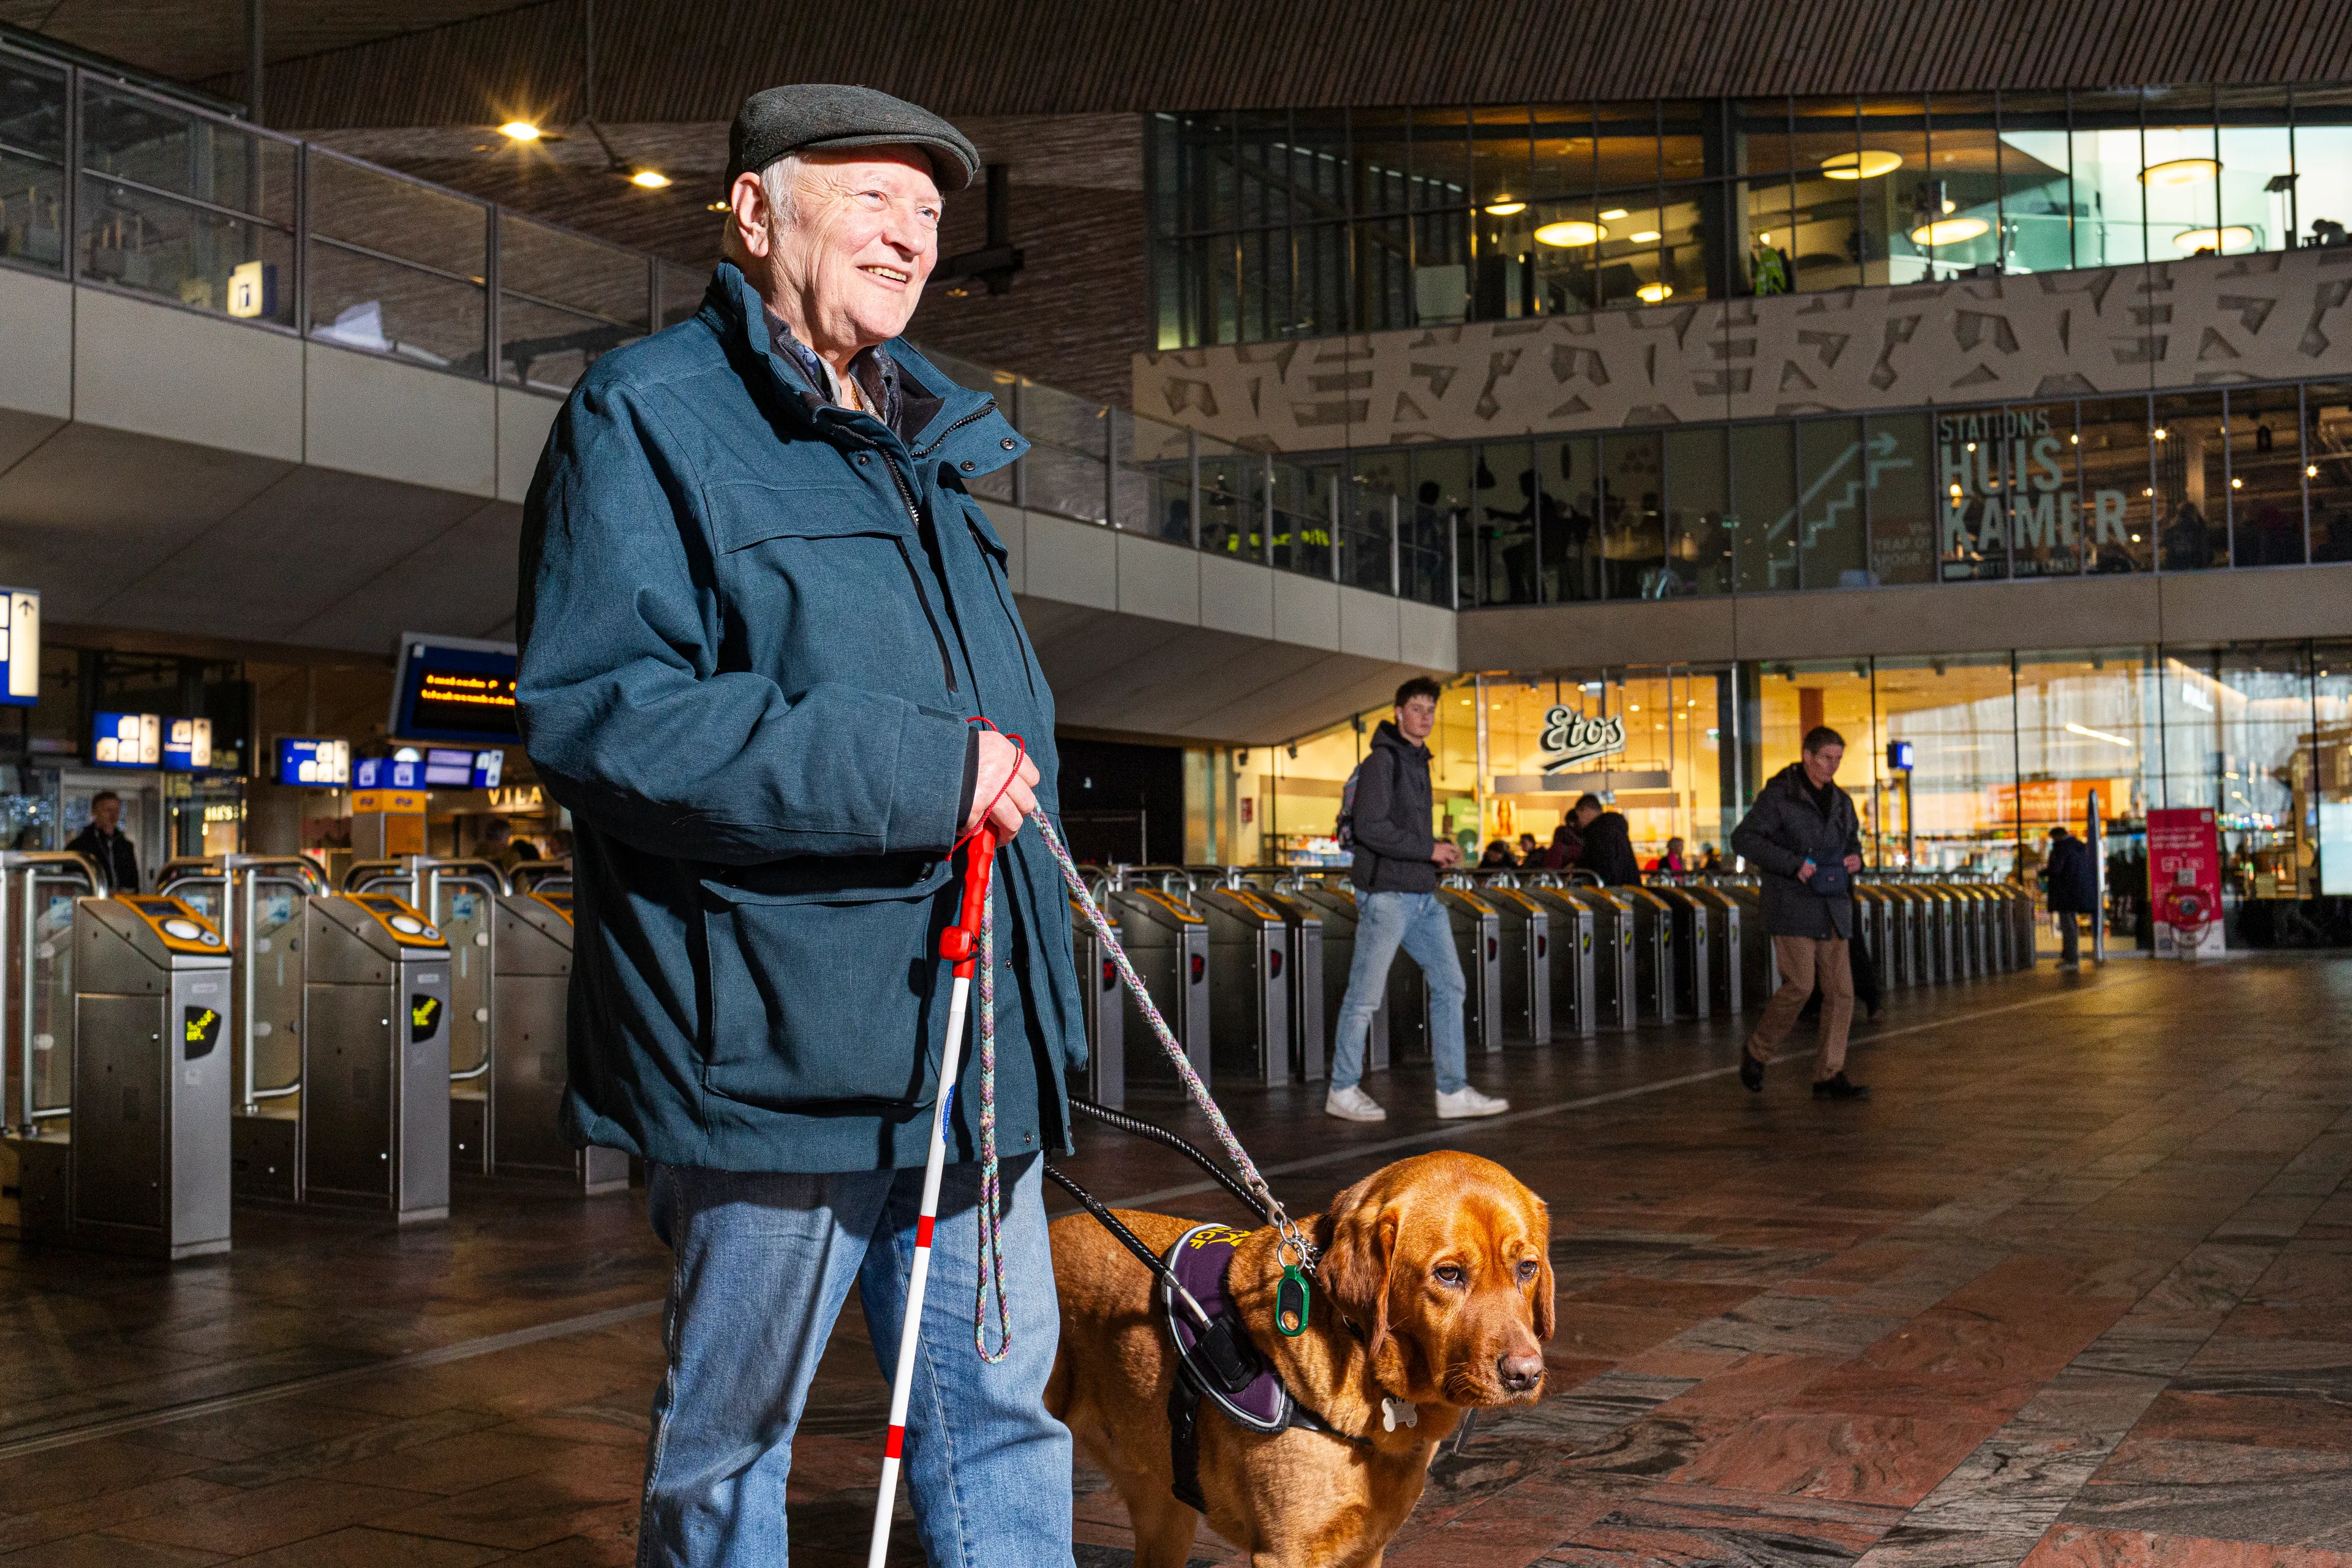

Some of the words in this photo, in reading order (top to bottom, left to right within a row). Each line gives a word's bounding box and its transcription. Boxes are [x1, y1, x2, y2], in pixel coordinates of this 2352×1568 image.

[1940, 409, 2050, 442] STATIONS
[1941, 437, 2063, 496] HUIS
[1942, 489, 2128, 552] KAMER
[1539, 704, 1626, 755] Etos
[488, 786, 543, 806] VILA
